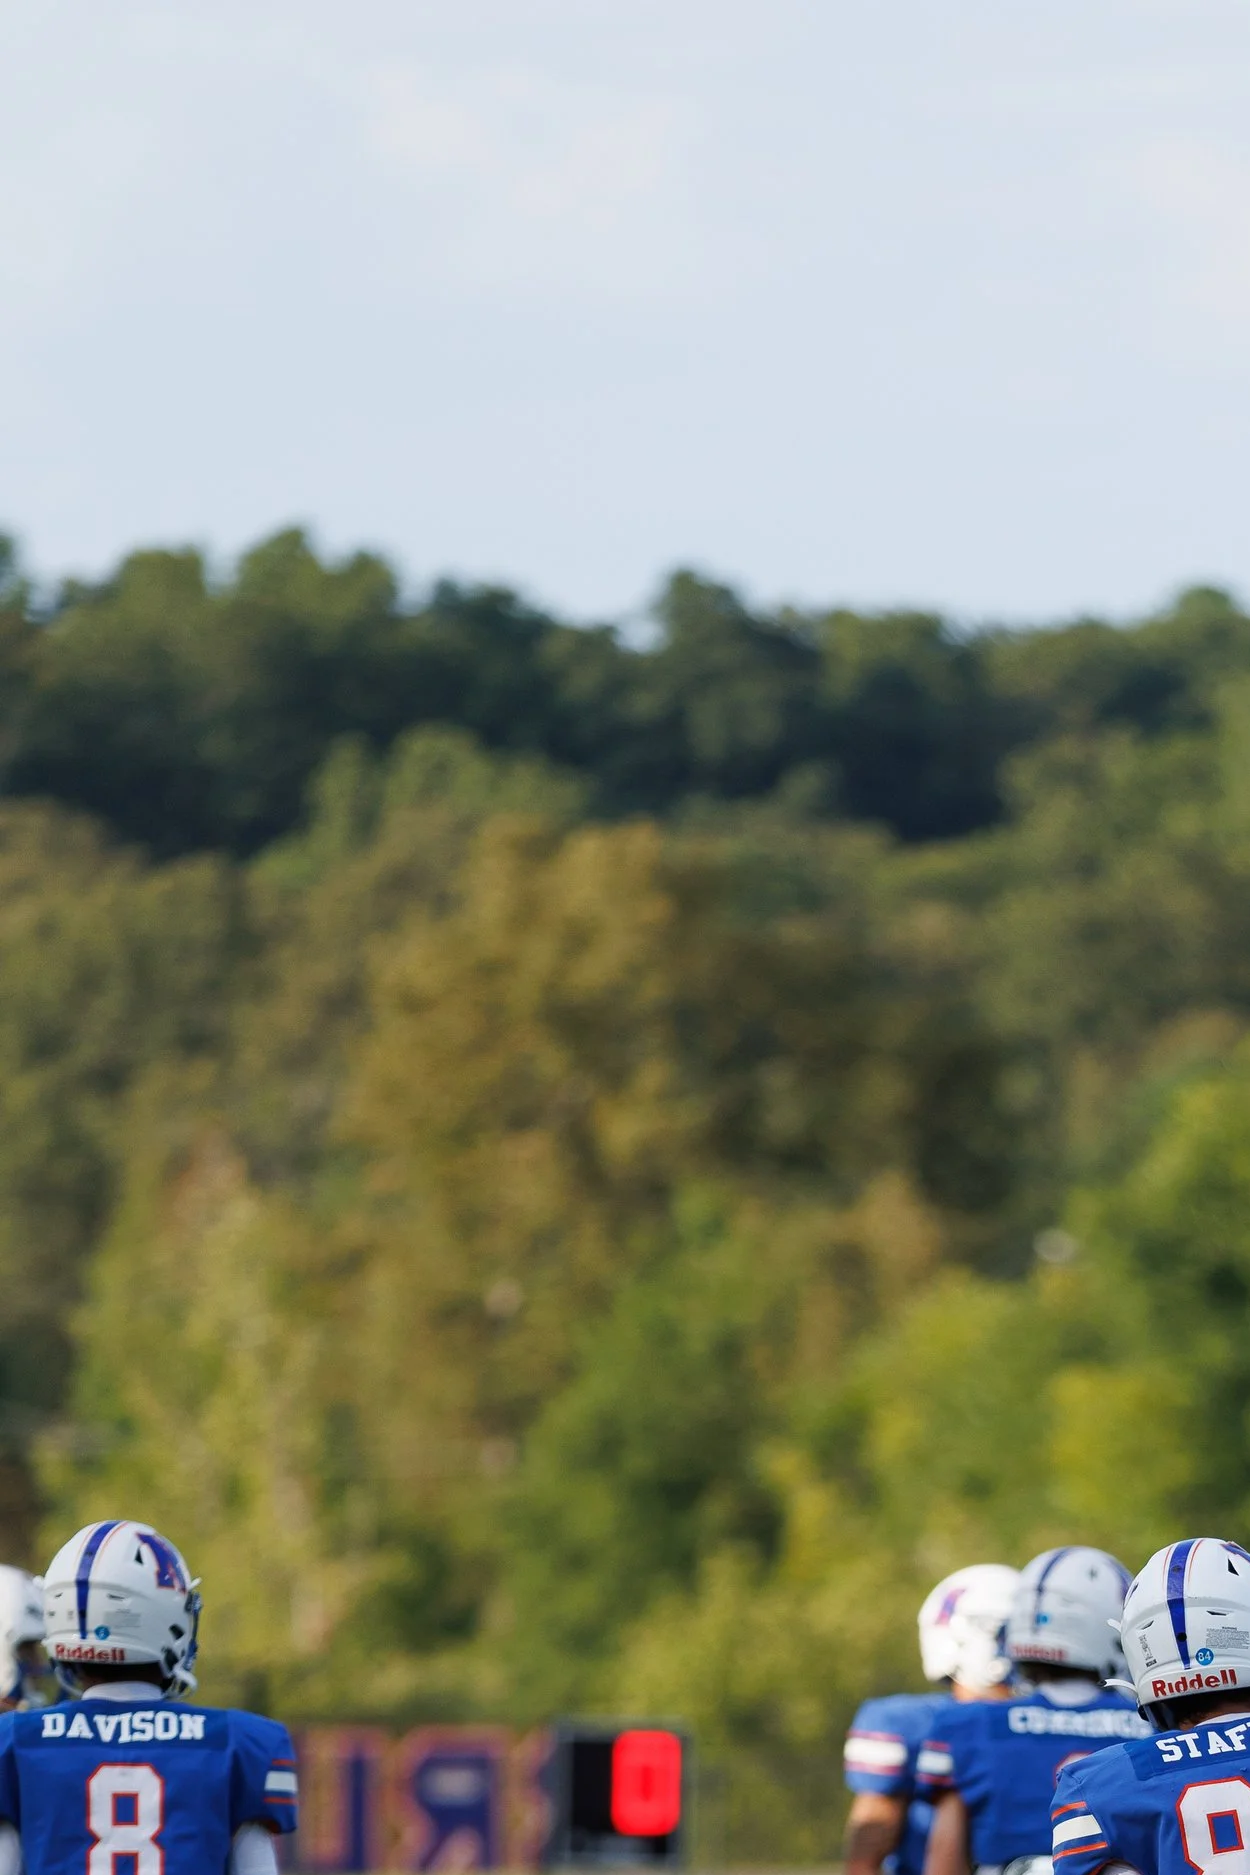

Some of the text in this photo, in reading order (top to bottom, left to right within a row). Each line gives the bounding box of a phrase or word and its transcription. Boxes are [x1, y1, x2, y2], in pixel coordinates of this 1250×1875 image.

[55, 1643, 126, 1662] Riddell
[1198, 1650, 1212, 1662] 84
[1151, 1669, 1238, 1698] Riddell
[41, 1710, 206, 1744] DAVISON
[612, 1729, 682, 1837] 0
